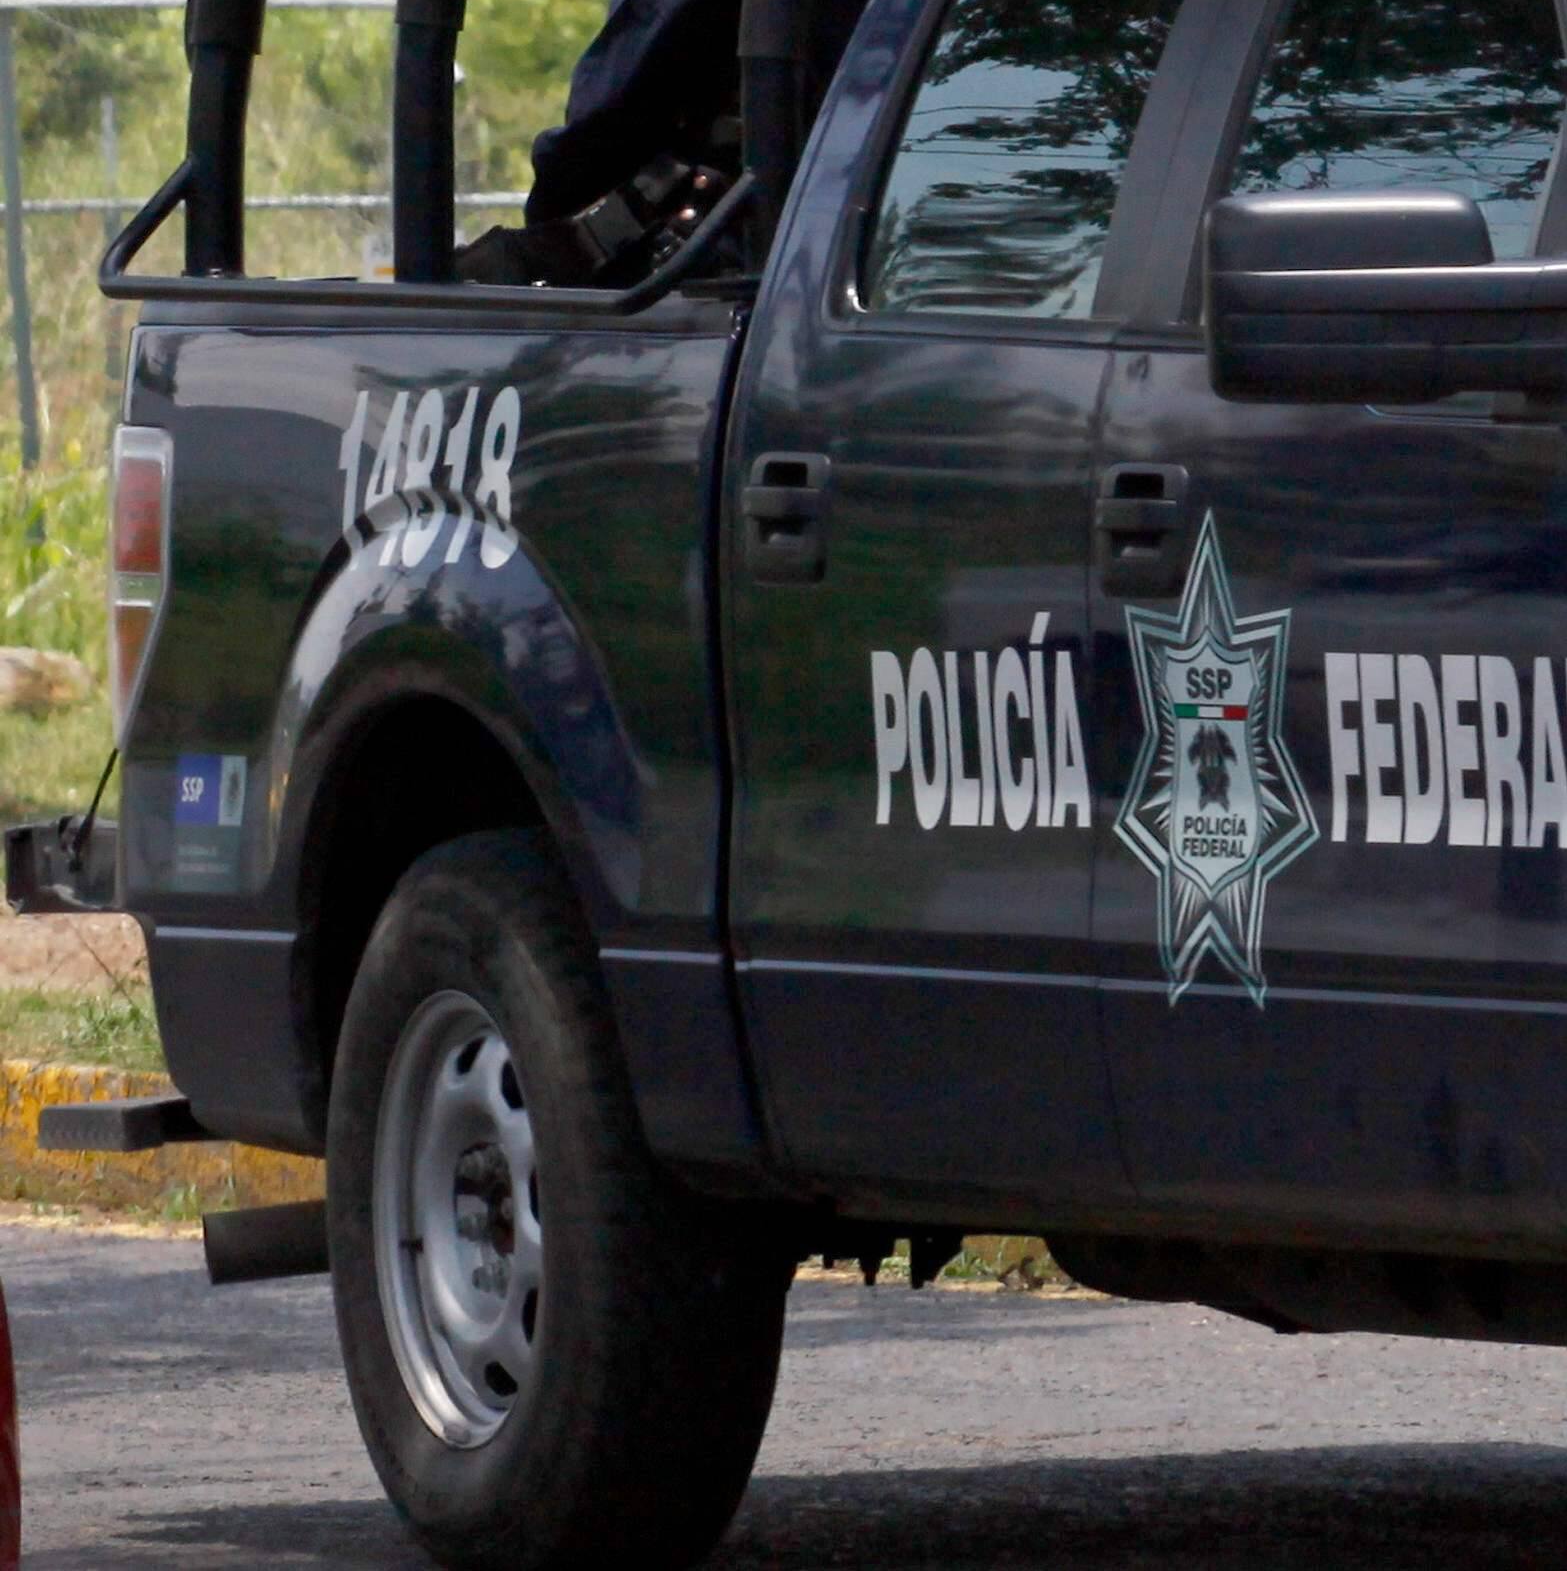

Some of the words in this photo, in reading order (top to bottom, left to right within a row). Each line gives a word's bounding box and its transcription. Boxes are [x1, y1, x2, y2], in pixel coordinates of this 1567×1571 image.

[338, 385, 522, 570] 14818
[1186, 667, 1232, 700] SSP
[871, 611, 1091, 830] POLICÍA
[182, 776, 204, 803] SSP
[1183, 812, 1248, 837] POLICÍA
[1182, 835, 1247, 860] FEDERAL
